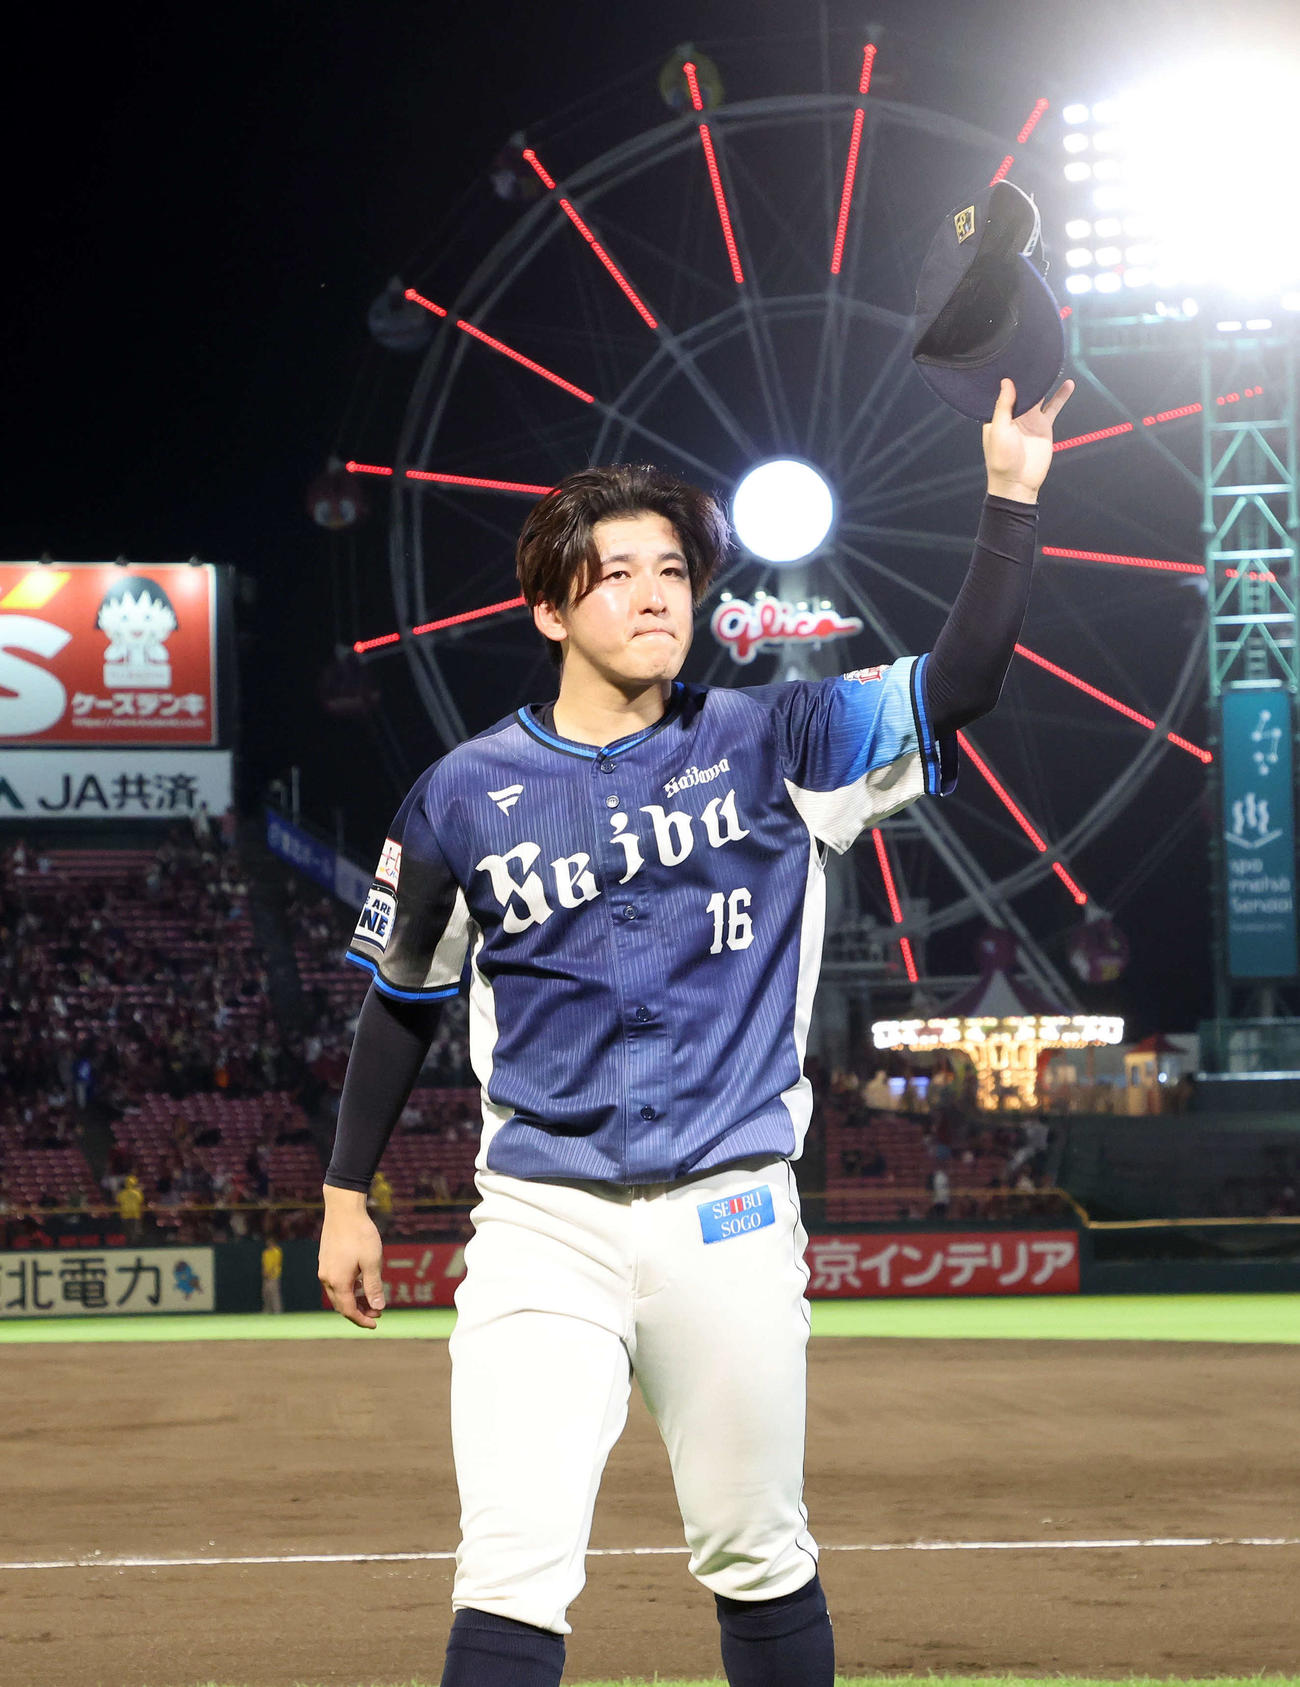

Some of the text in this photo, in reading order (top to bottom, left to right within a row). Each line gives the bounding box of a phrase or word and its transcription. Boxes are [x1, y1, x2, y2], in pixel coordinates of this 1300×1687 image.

[716, 603, 859, 659] Glico
[663, 758, 730, 798] Saitama
[475, 788, 750, 934] Seibu
[706, 887, 755, 954] 16
[712, 1191, 762, 1219] SEIBU
[721, 1212, 762, 1237] SOGO
[0, 1258, 161, 1310] 北電力
[811, 1240, 1075, 1290] 京インテリア
